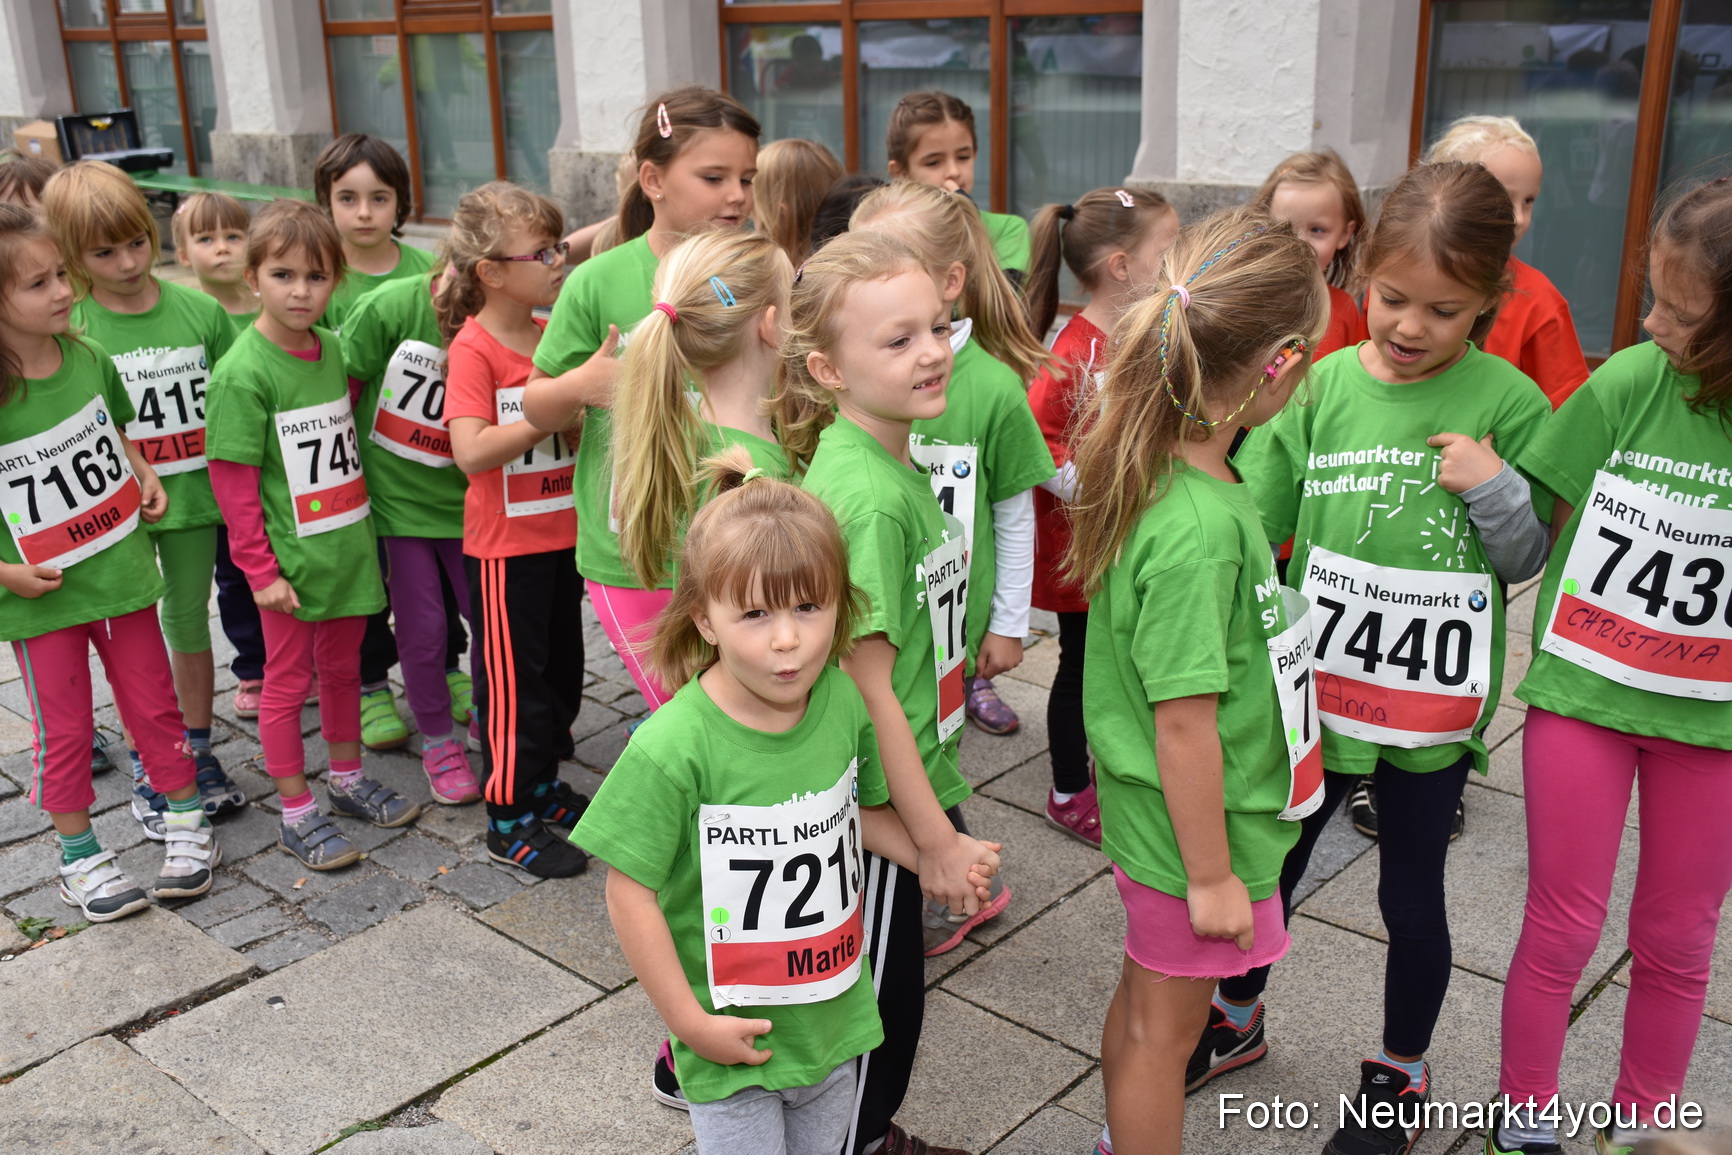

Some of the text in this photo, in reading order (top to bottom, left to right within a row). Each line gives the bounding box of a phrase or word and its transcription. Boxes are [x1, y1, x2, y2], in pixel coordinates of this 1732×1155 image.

[138, 361, 196, 381] Neumarkt
[397, 349, 439, 372] PARTL
[120, 377, 206, 432] 415
[397, 369, 446, 421] 70
[501, 402, 523, 414] PA
[36, 422, 97, 461] Neumarkt
[281, 418, 328, 437] PARTL
[409, 429, 453, 454] Anou
[297, 426, 361, 485] 743
[509, 465, 515, 474] 1
[8, 435, 123, 524] 7163
[541, 474, 574, 495] Anto
[1304, 472, 1394, 498] Stadtlauf
[67, 506, 122, 543] Helga
[1592, 491, 1650, 532] PARTL
[928, 559, 960, 592] PARTL
[1309, 564, 1460, 609] PARTL Neumarkt
[1590, 526, 1732, 628] 743
[1277, 635, 1312, 675] PARTL
[1314, 595, 1473, 687] 7440
[1567, 607, 1720, 665] CHRISTINA
[1321, 673, 1387, 724] Anna
[1470, 682, 1478, 694] K
[706, 826, 788, 846] PARTL
[729, 817, 861, 931] 7213
[716, 928, 725, 941] 1
[787, 934, 855, 978] Marie
